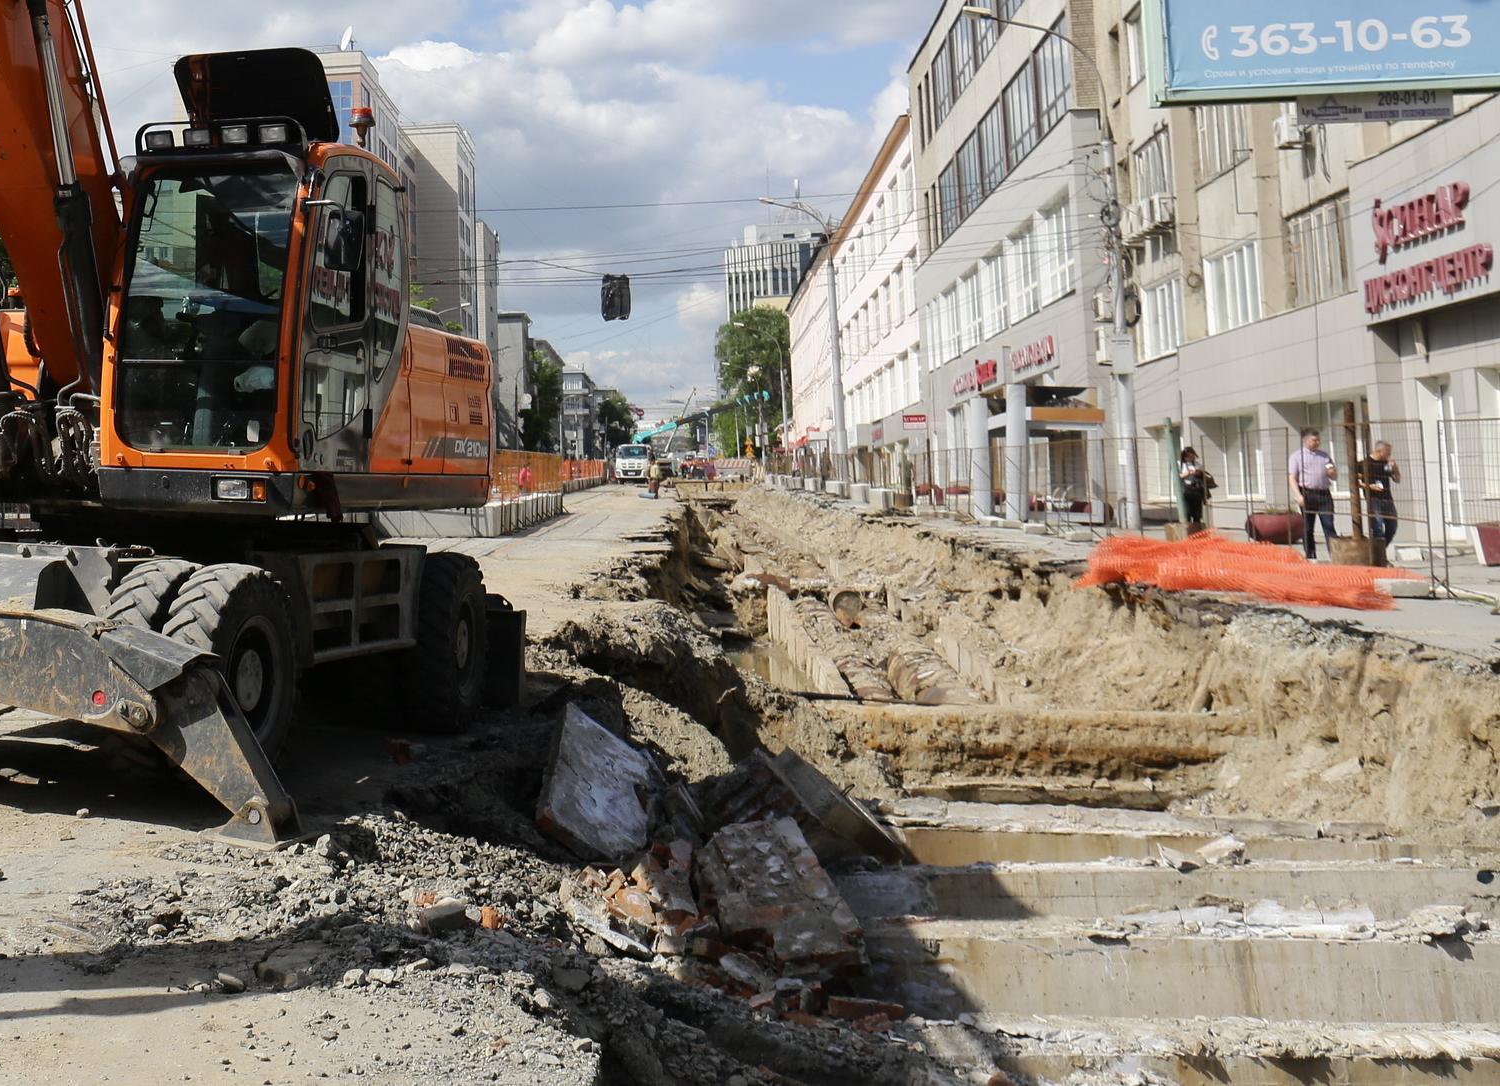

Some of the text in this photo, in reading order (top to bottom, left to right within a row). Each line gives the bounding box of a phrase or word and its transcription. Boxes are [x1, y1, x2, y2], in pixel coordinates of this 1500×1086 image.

[1230, 14, 1472, 58] 363-10-63
[1327, 61, 1383, 75] уточняйте
[1385, 61, 1399, 70] по
[1401, 58, 1457, 70] телефону
[1378, 90, 1437, 106] 209-01-01
